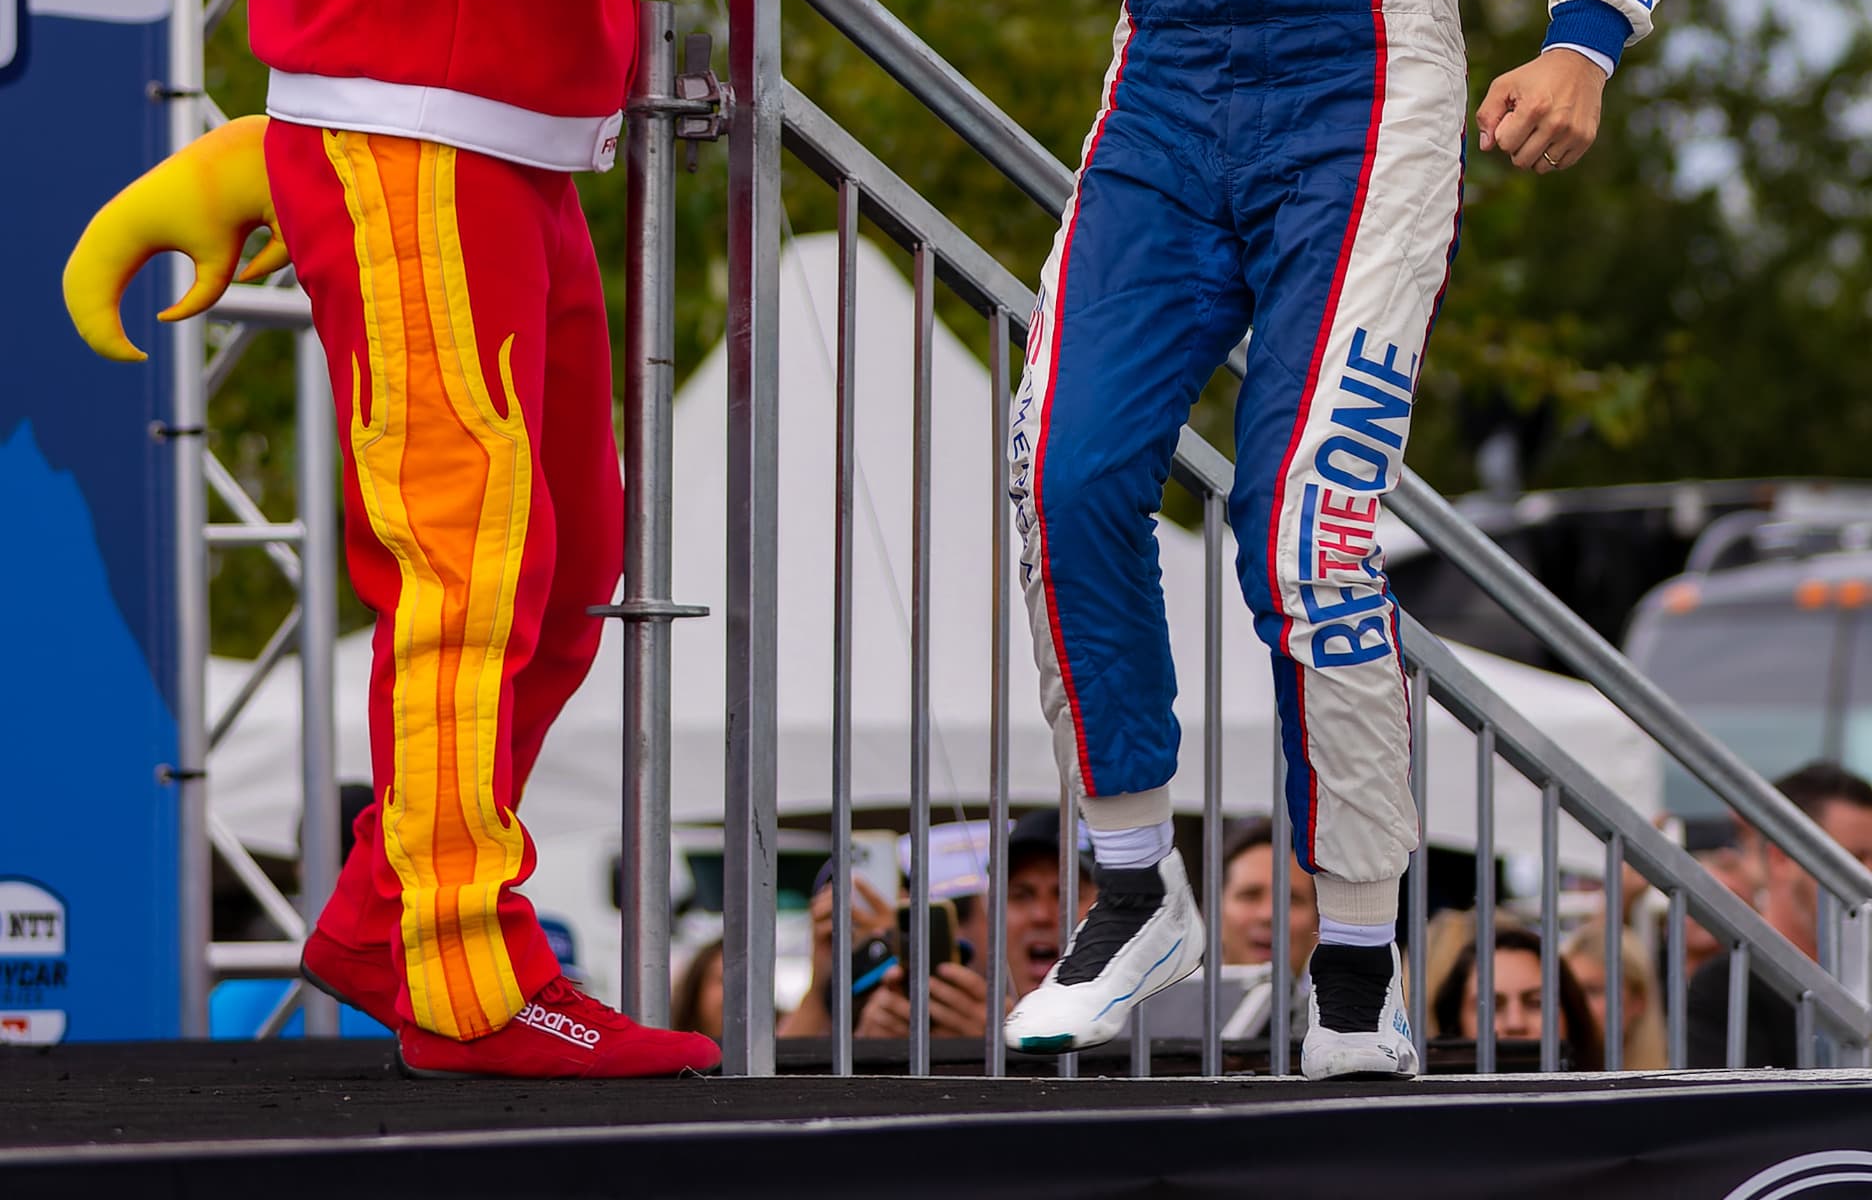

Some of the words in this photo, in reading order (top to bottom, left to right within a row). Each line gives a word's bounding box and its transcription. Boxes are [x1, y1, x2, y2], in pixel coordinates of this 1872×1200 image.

[1314, 326, 1418, 492] ONE
[1318, 488, 1377, 579] THE
[9, 912, 58, 938] NTT
[0, 961, 67, 987] YCAR
